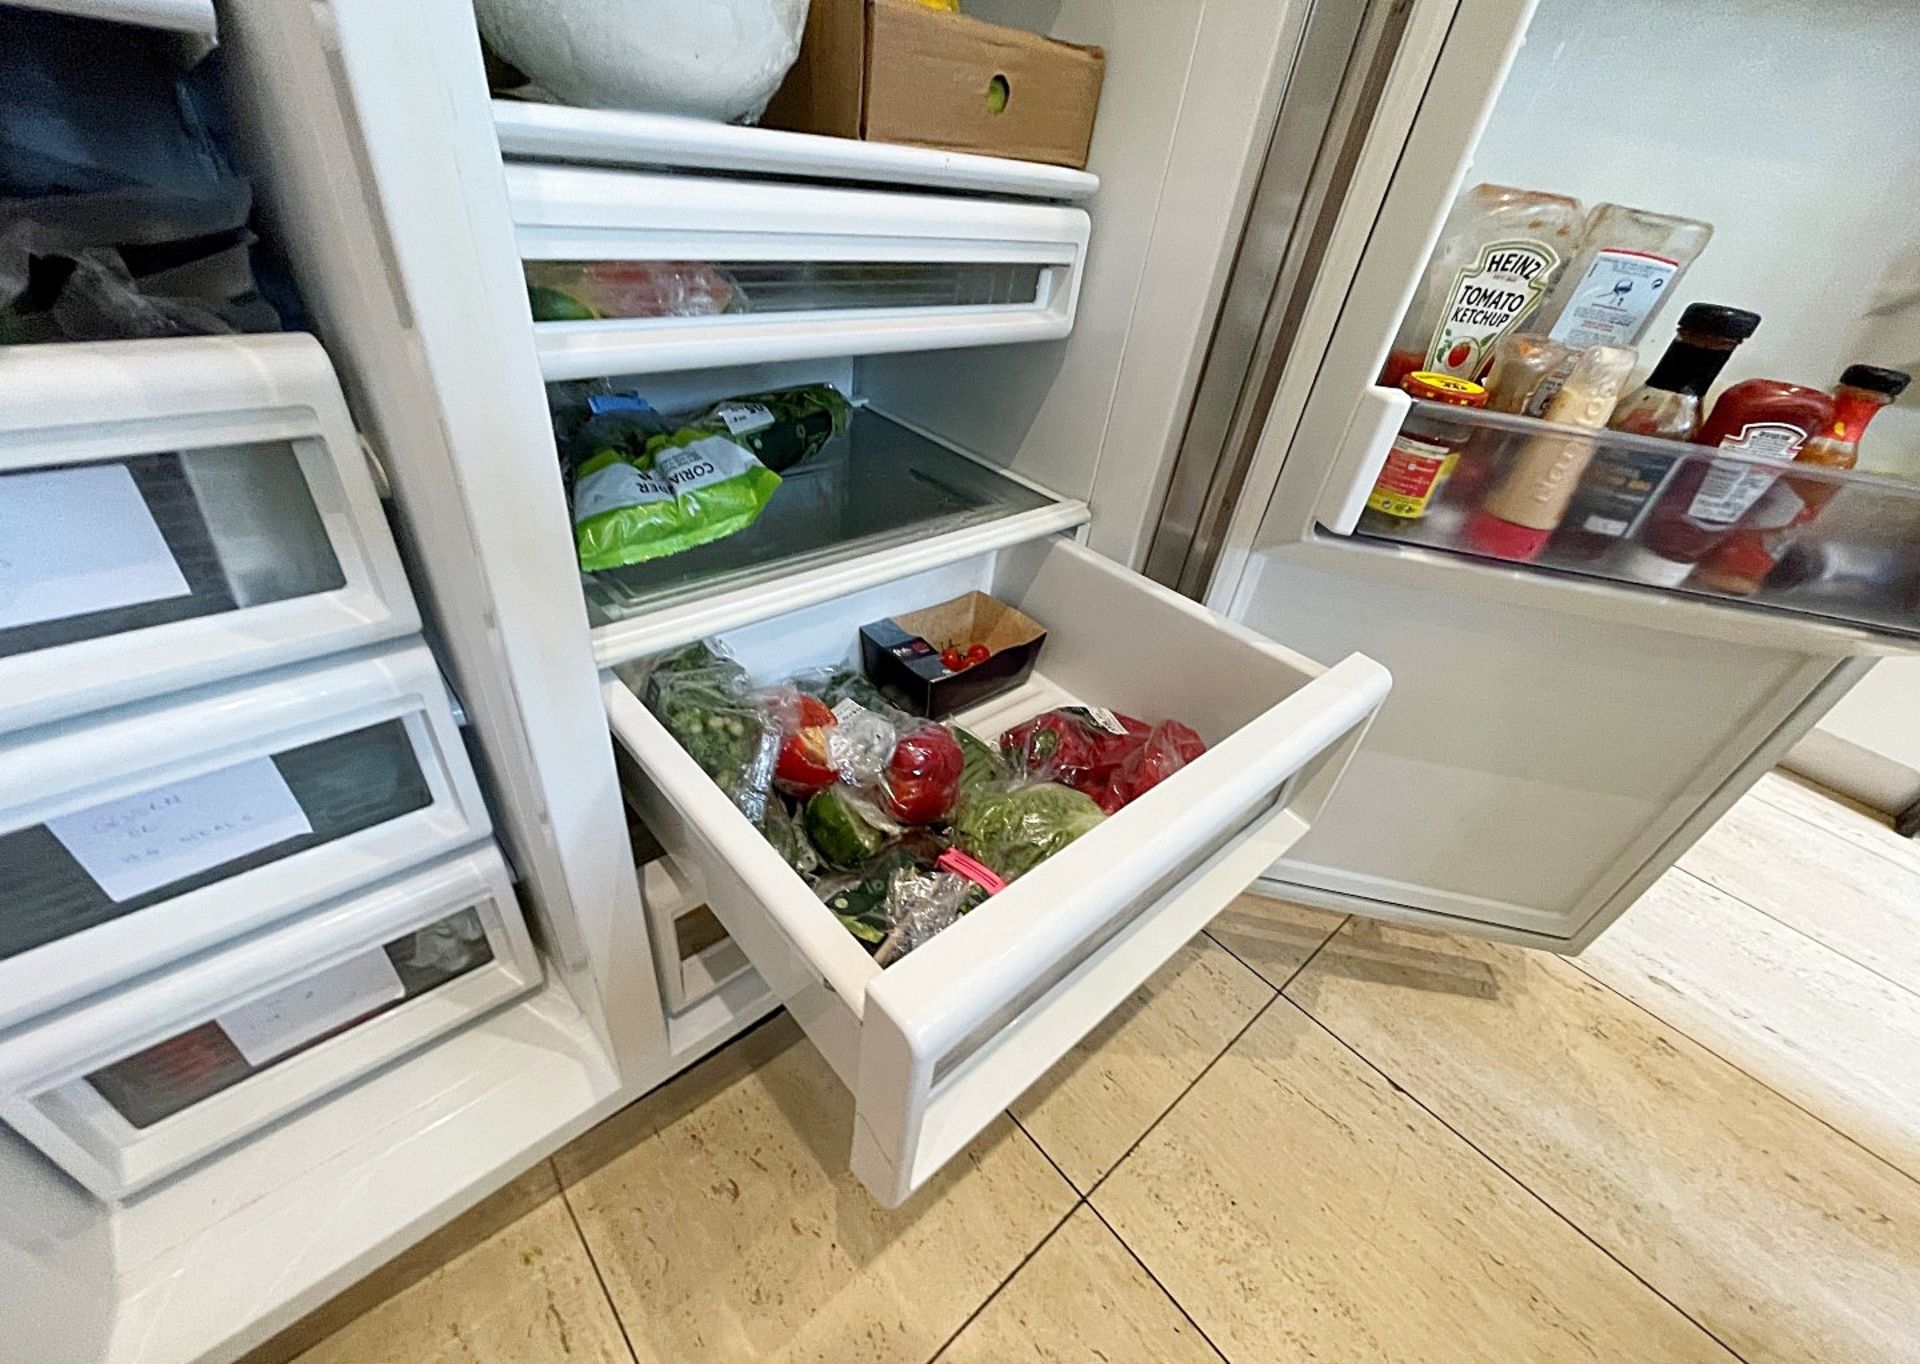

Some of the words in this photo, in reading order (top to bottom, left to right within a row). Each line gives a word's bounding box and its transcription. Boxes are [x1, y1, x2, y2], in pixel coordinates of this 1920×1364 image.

[1486, 253, 1542, 280] HEINZ
[1458, 285, 1525, 313] TOMATO
[1451, 307, 1510, 328] KETCHUP
